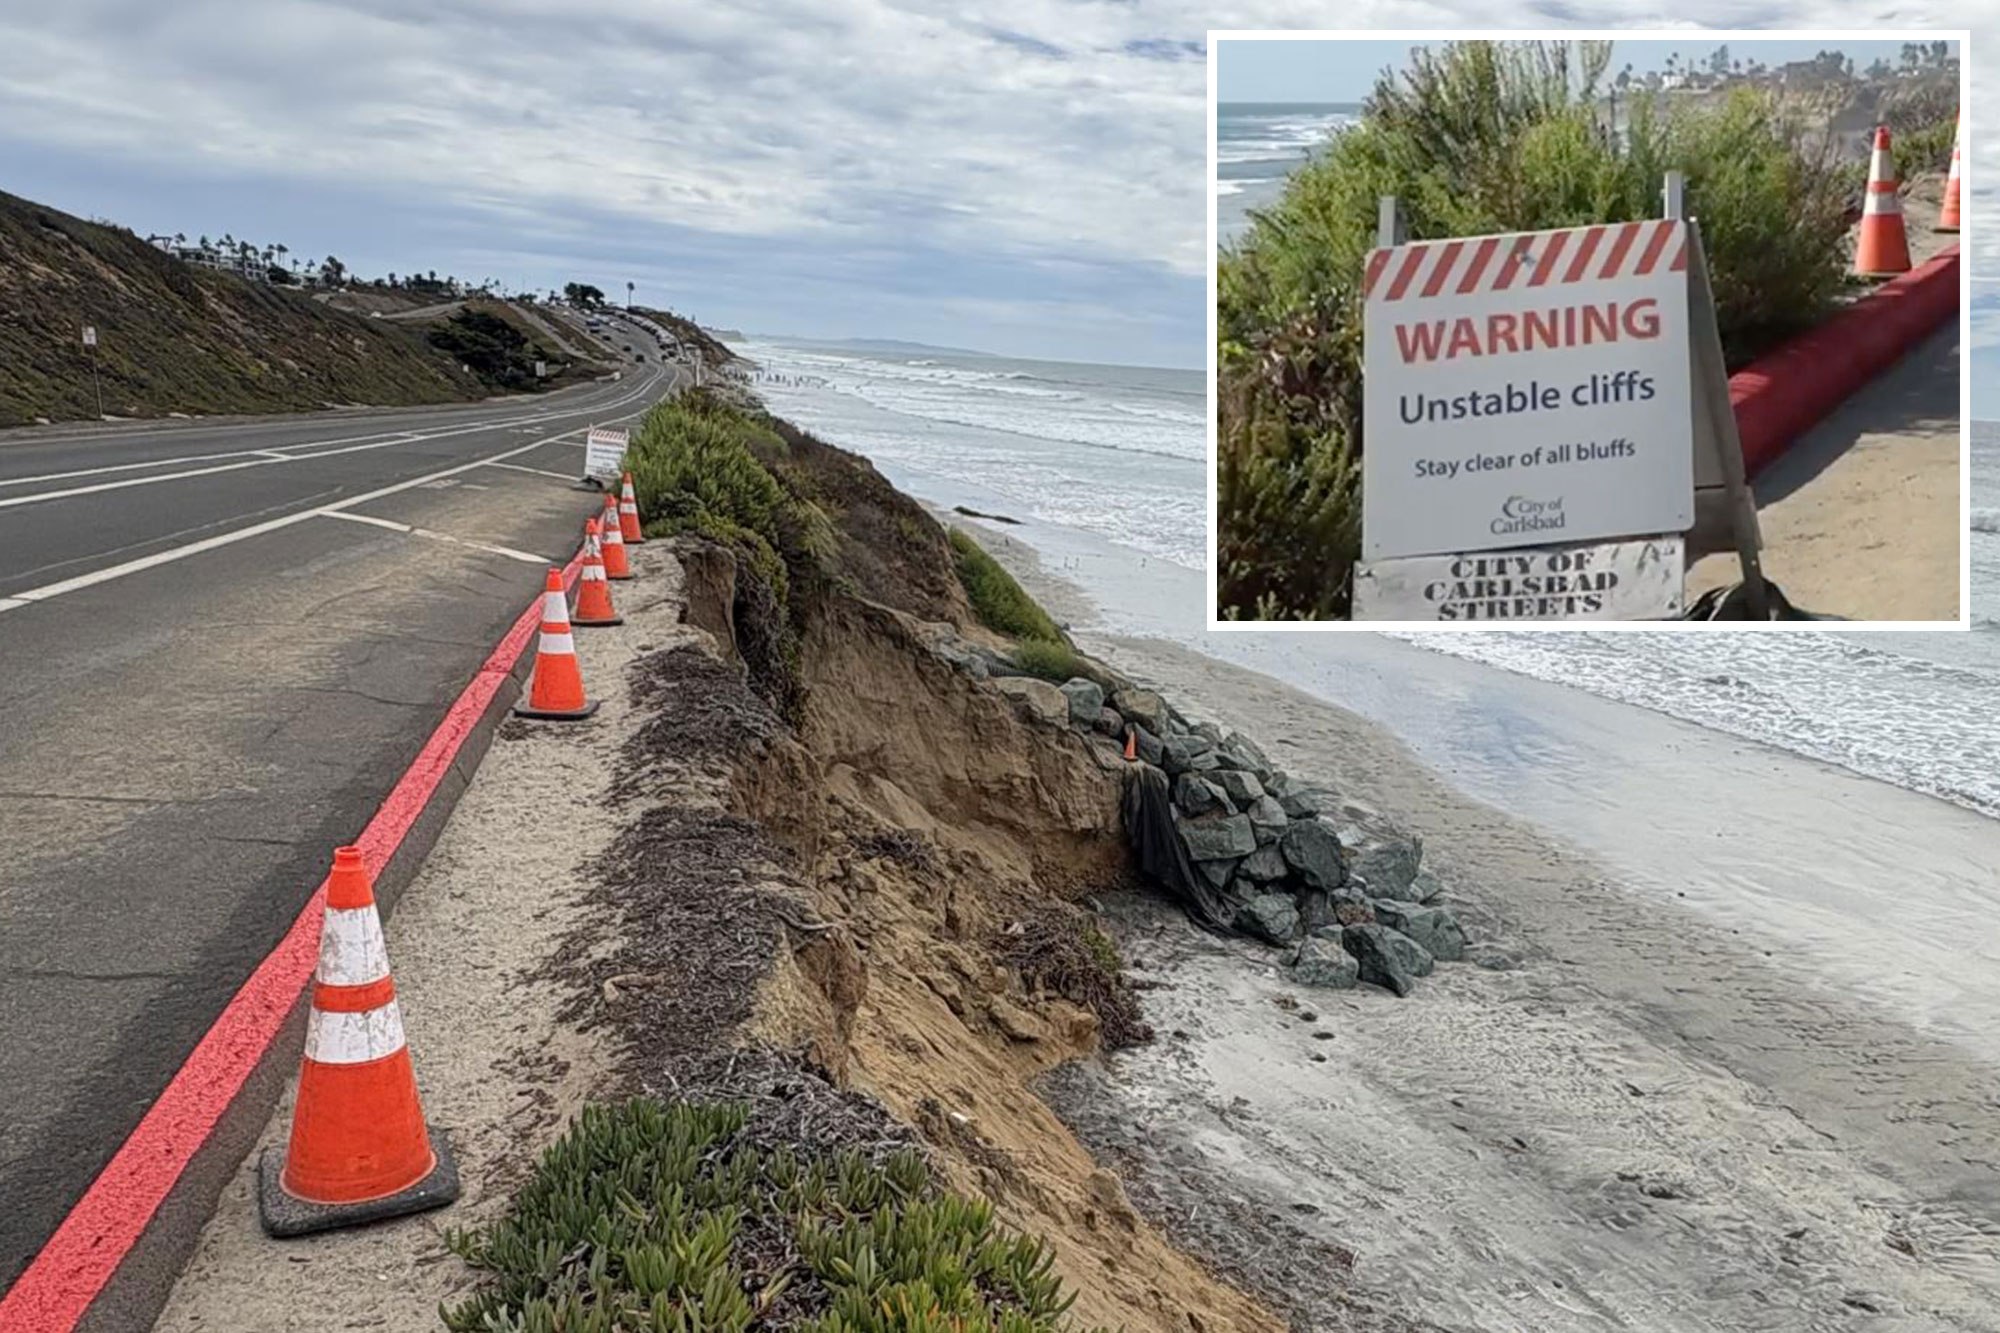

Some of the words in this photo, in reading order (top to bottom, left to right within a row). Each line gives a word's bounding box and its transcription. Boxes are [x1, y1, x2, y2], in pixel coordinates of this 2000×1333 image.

[1395, 298, 1660, 364] WARNING
[1400, 381, 1560, 423] Unstable
[1572, 371, 1655, 407] cliffs
[1415, 459, 1460, 479] Stay
[1465, 452, 1514, 473] clear
[1521, 446, 1543, 467] of
[1547, 445, 1571, 463] all
[1577, 438, 1635, 461] bluffs
[1518, 500, 1544, 514] City
[1548, 497, 1563, 510] of
[1490, 512, 1565, 535] Carlsbad
[1451, 557, 1536, 578] CITY
[1548, 552, 1595, 572] OF
[1425, 571, 1618, 601] CARLSBAD
[1437, 593, 1602, 621] STREETS
